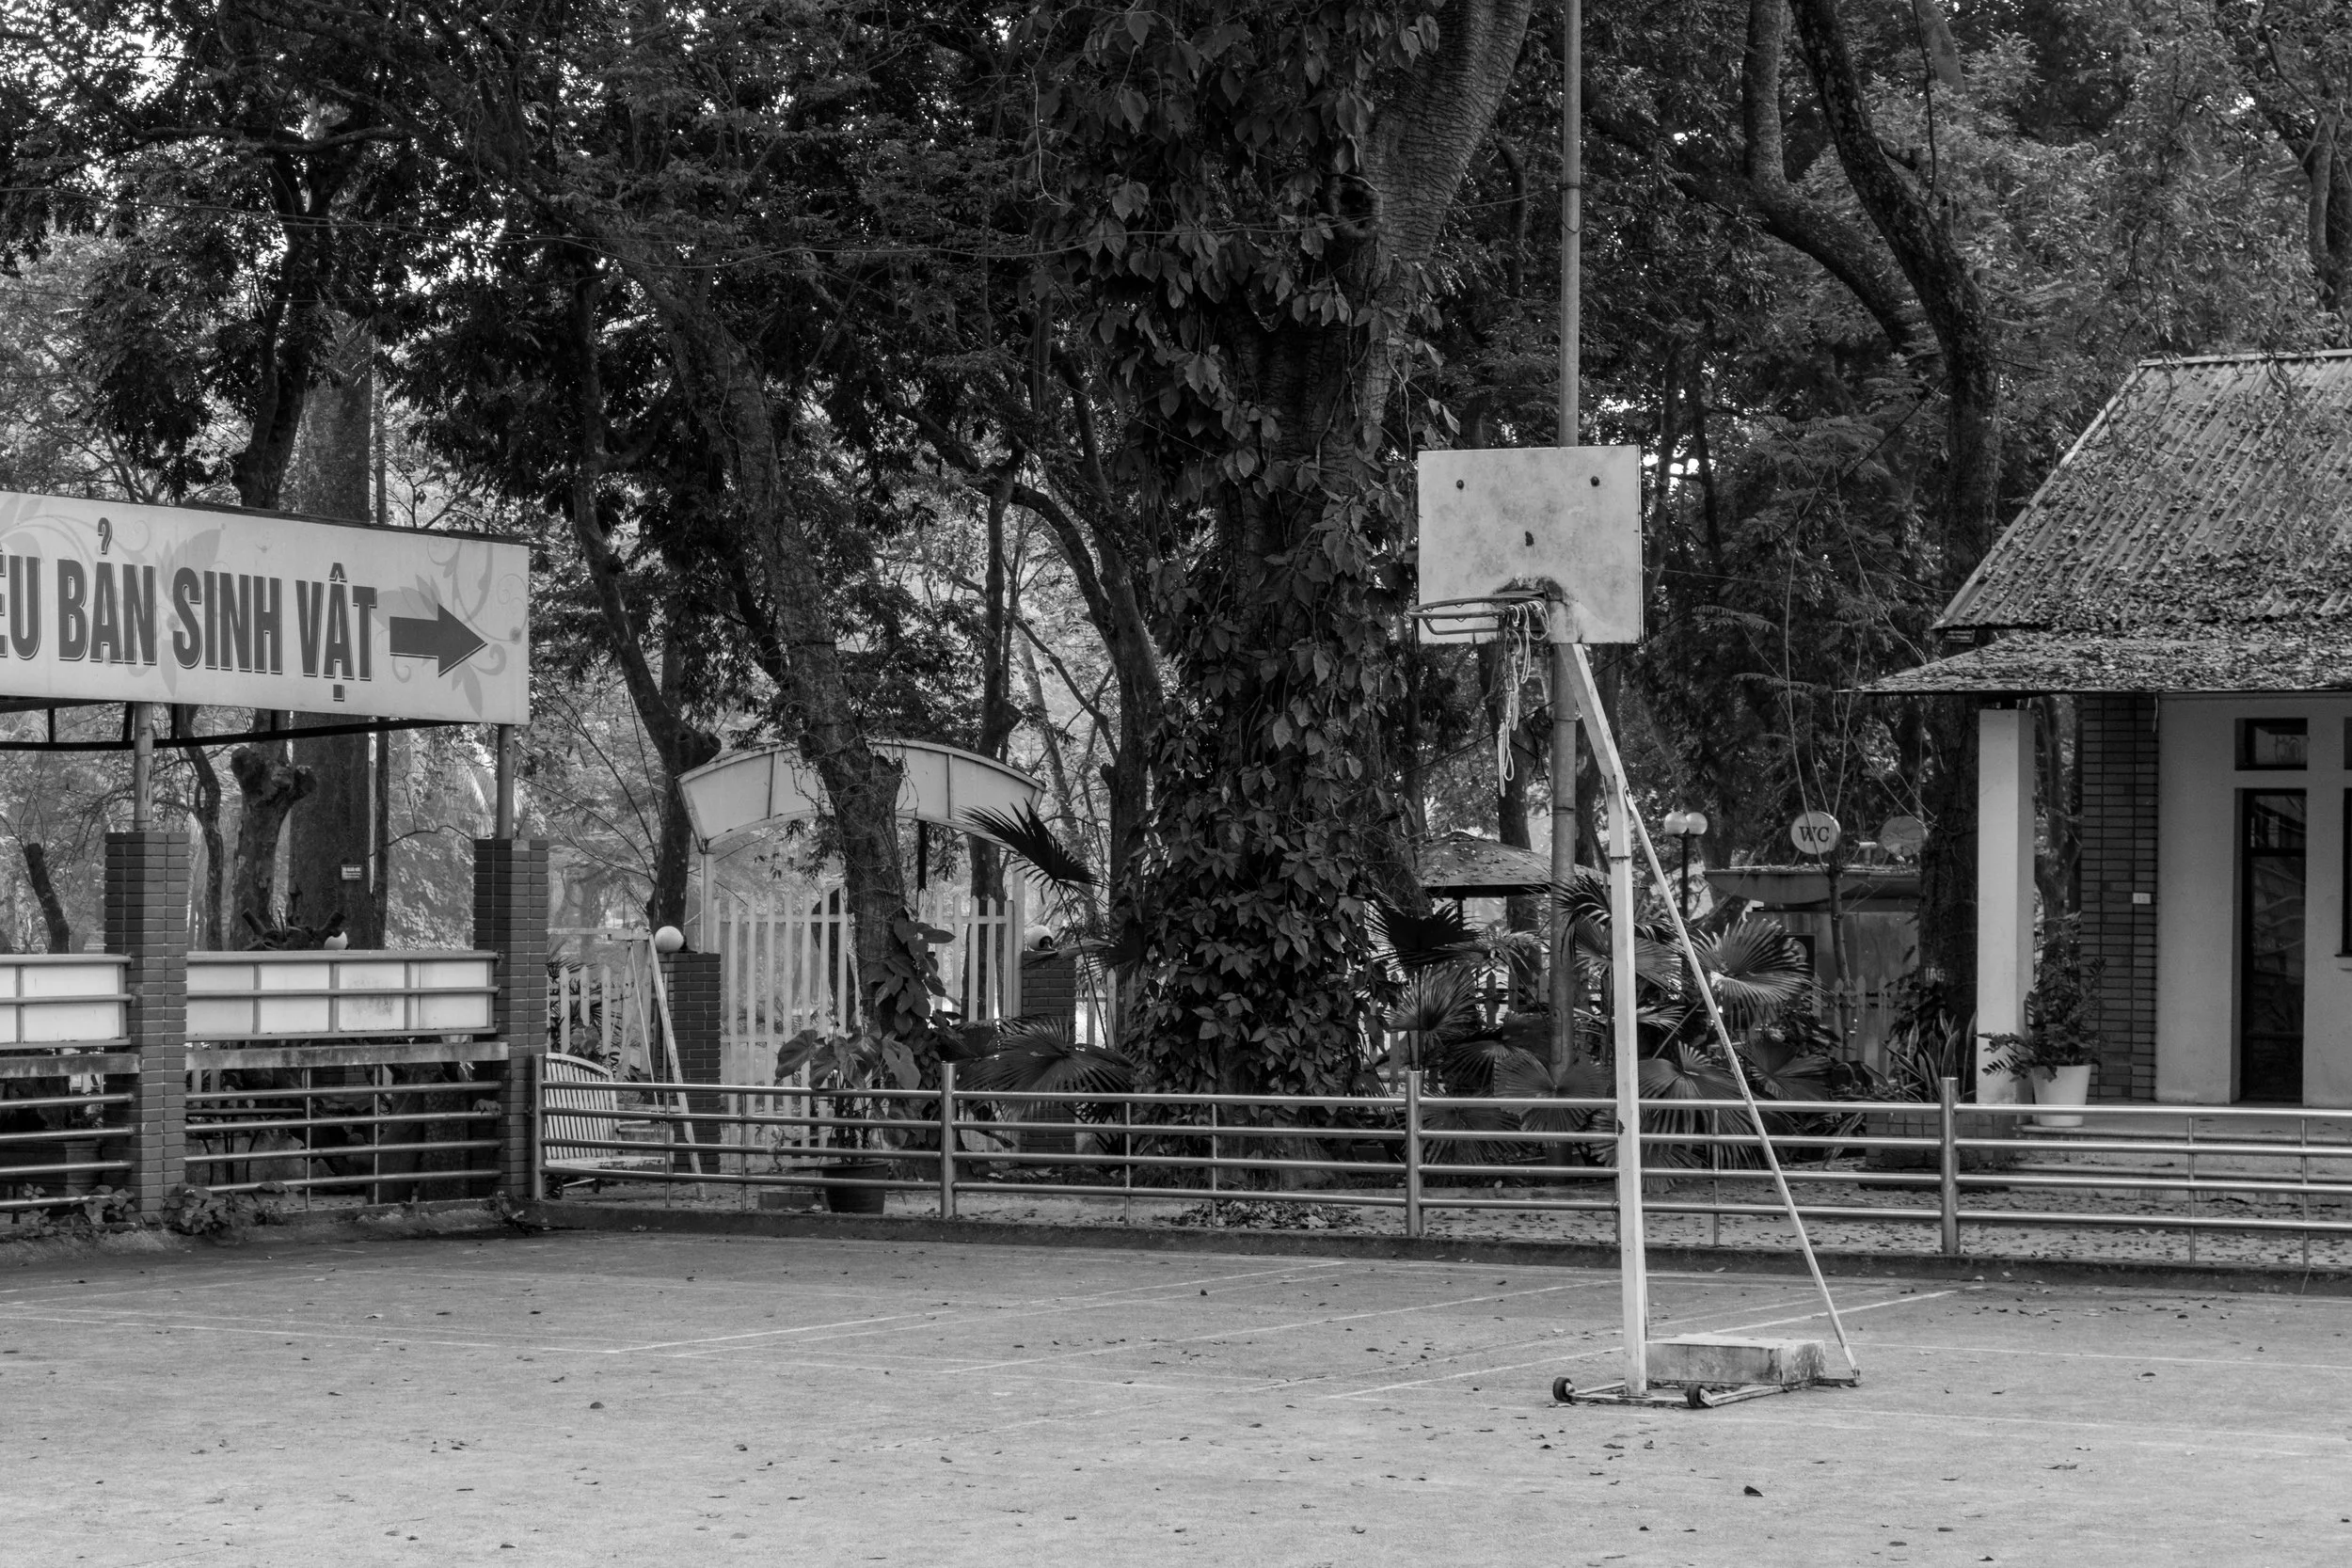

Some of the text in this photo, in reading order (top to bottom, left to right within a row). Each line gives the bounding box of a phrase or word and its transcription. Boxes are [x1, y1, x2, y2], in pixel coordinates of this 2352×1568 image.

[57, 516, 157, 665] BẢN
[172, 566, 283, 674] SINH
[295, 562, 377, 702] VẬT
[1799, 826, 1830, 843] WC
